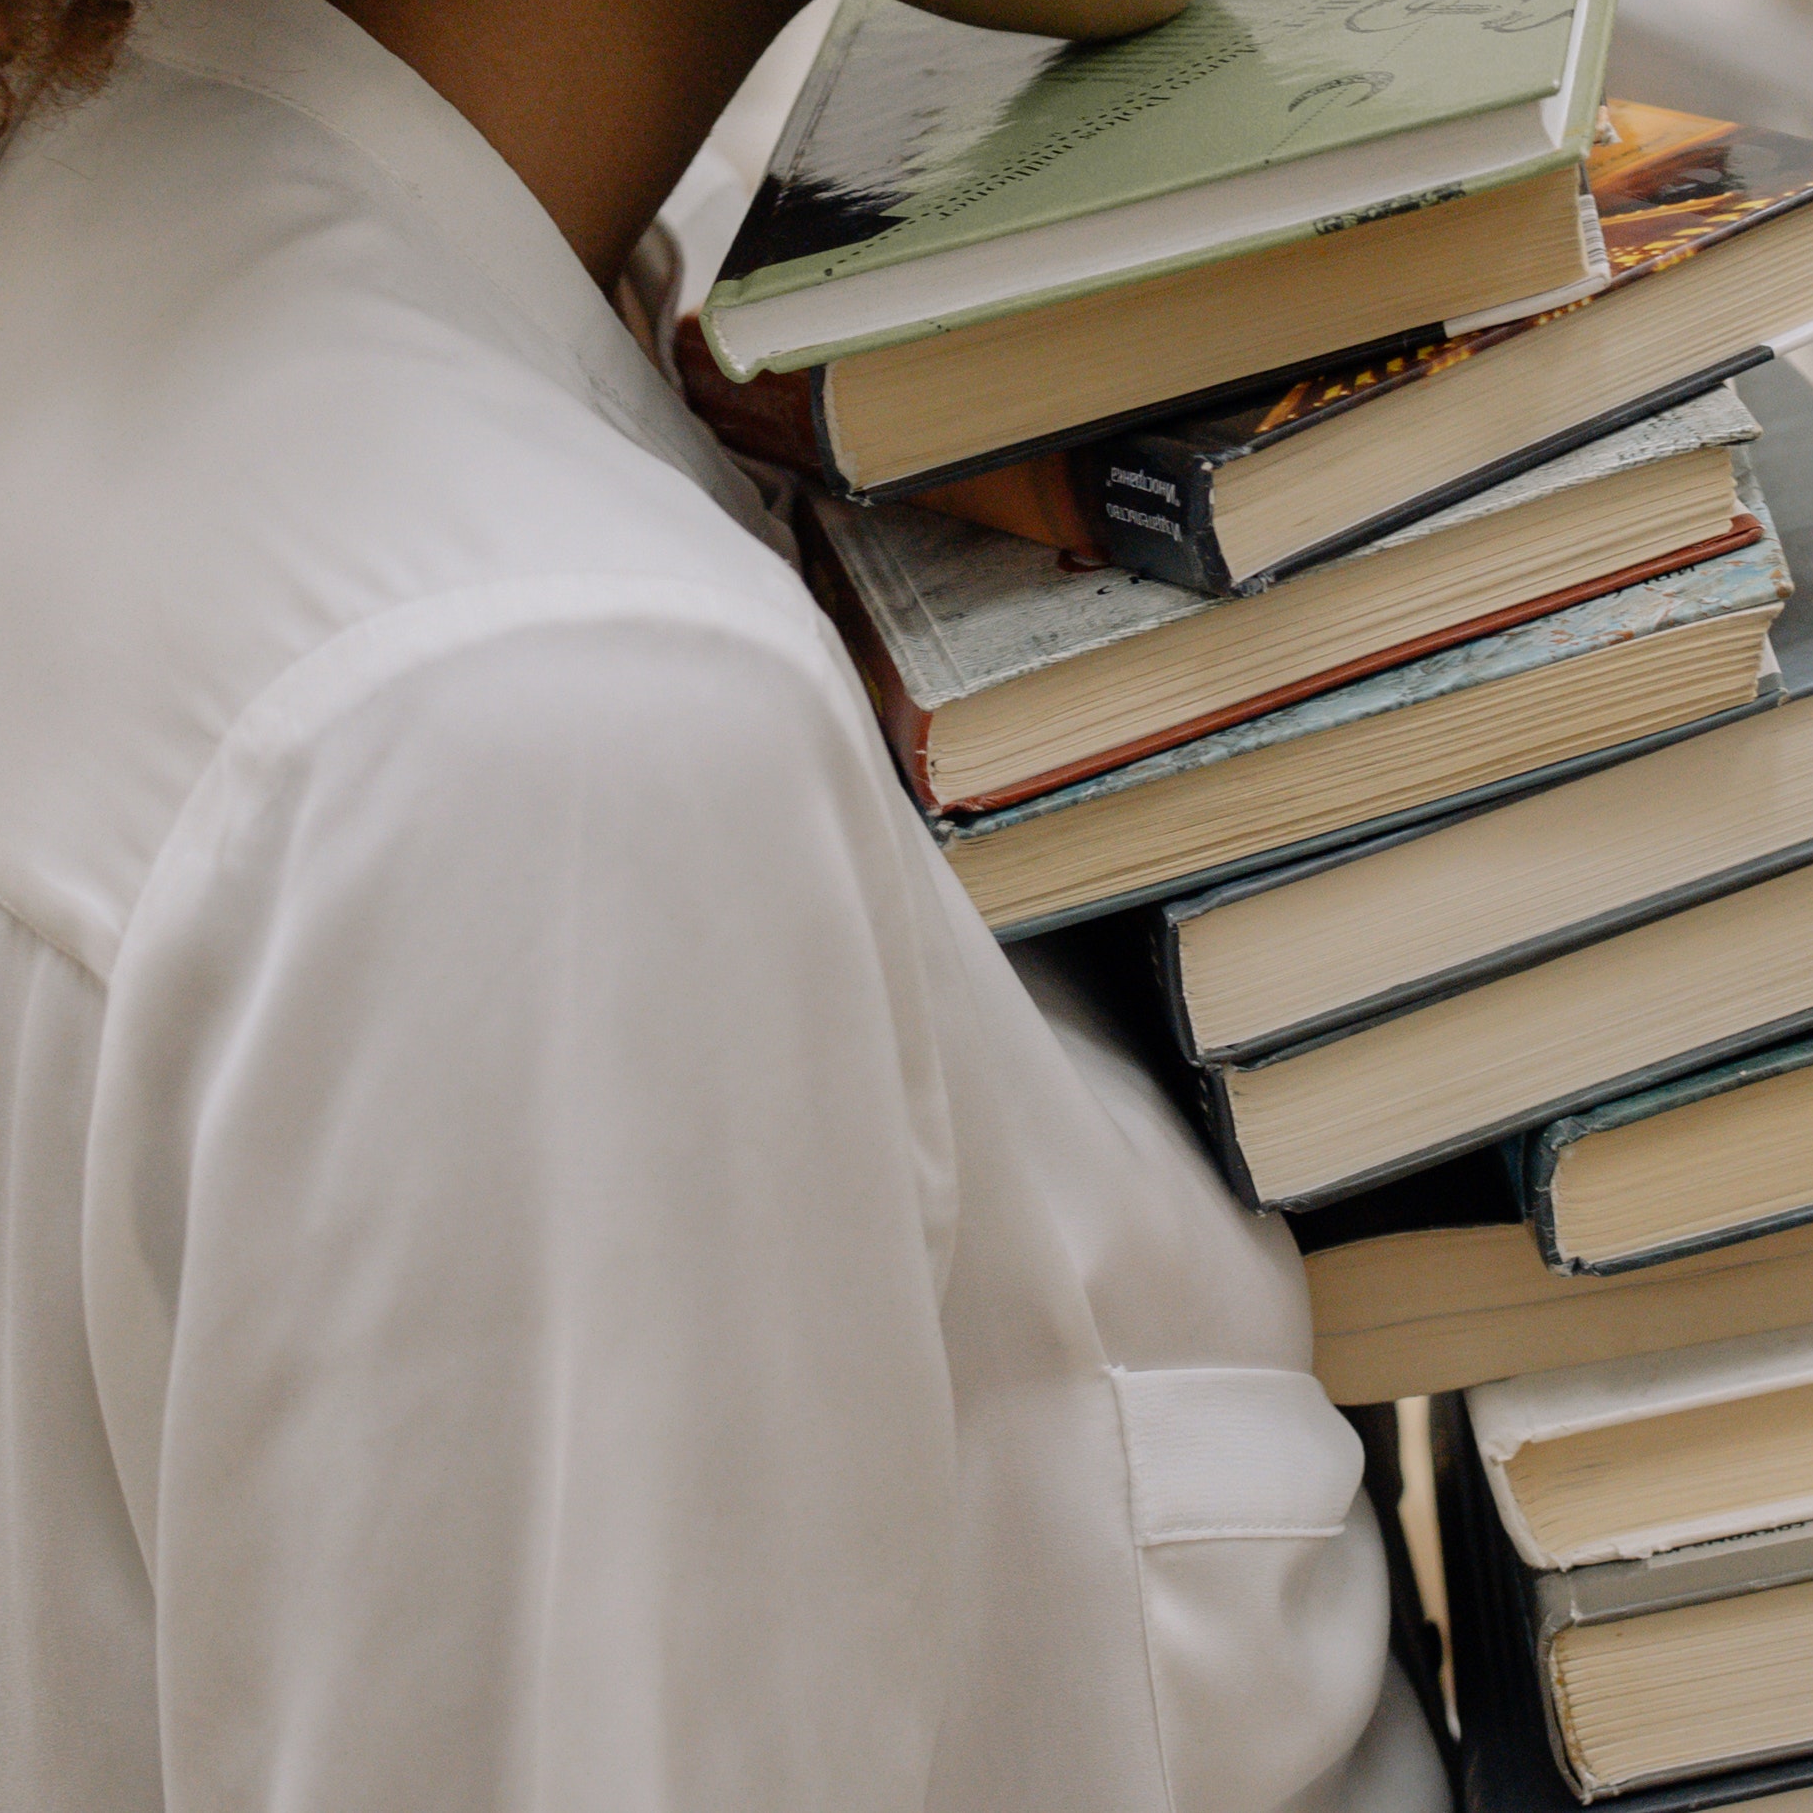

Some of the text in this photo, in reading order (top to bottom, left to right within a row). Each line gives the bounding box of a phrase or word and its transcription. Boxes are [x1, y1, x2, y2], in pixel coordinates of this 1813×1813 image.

[939, 35, 1275, 221] Marco Polos millioner
